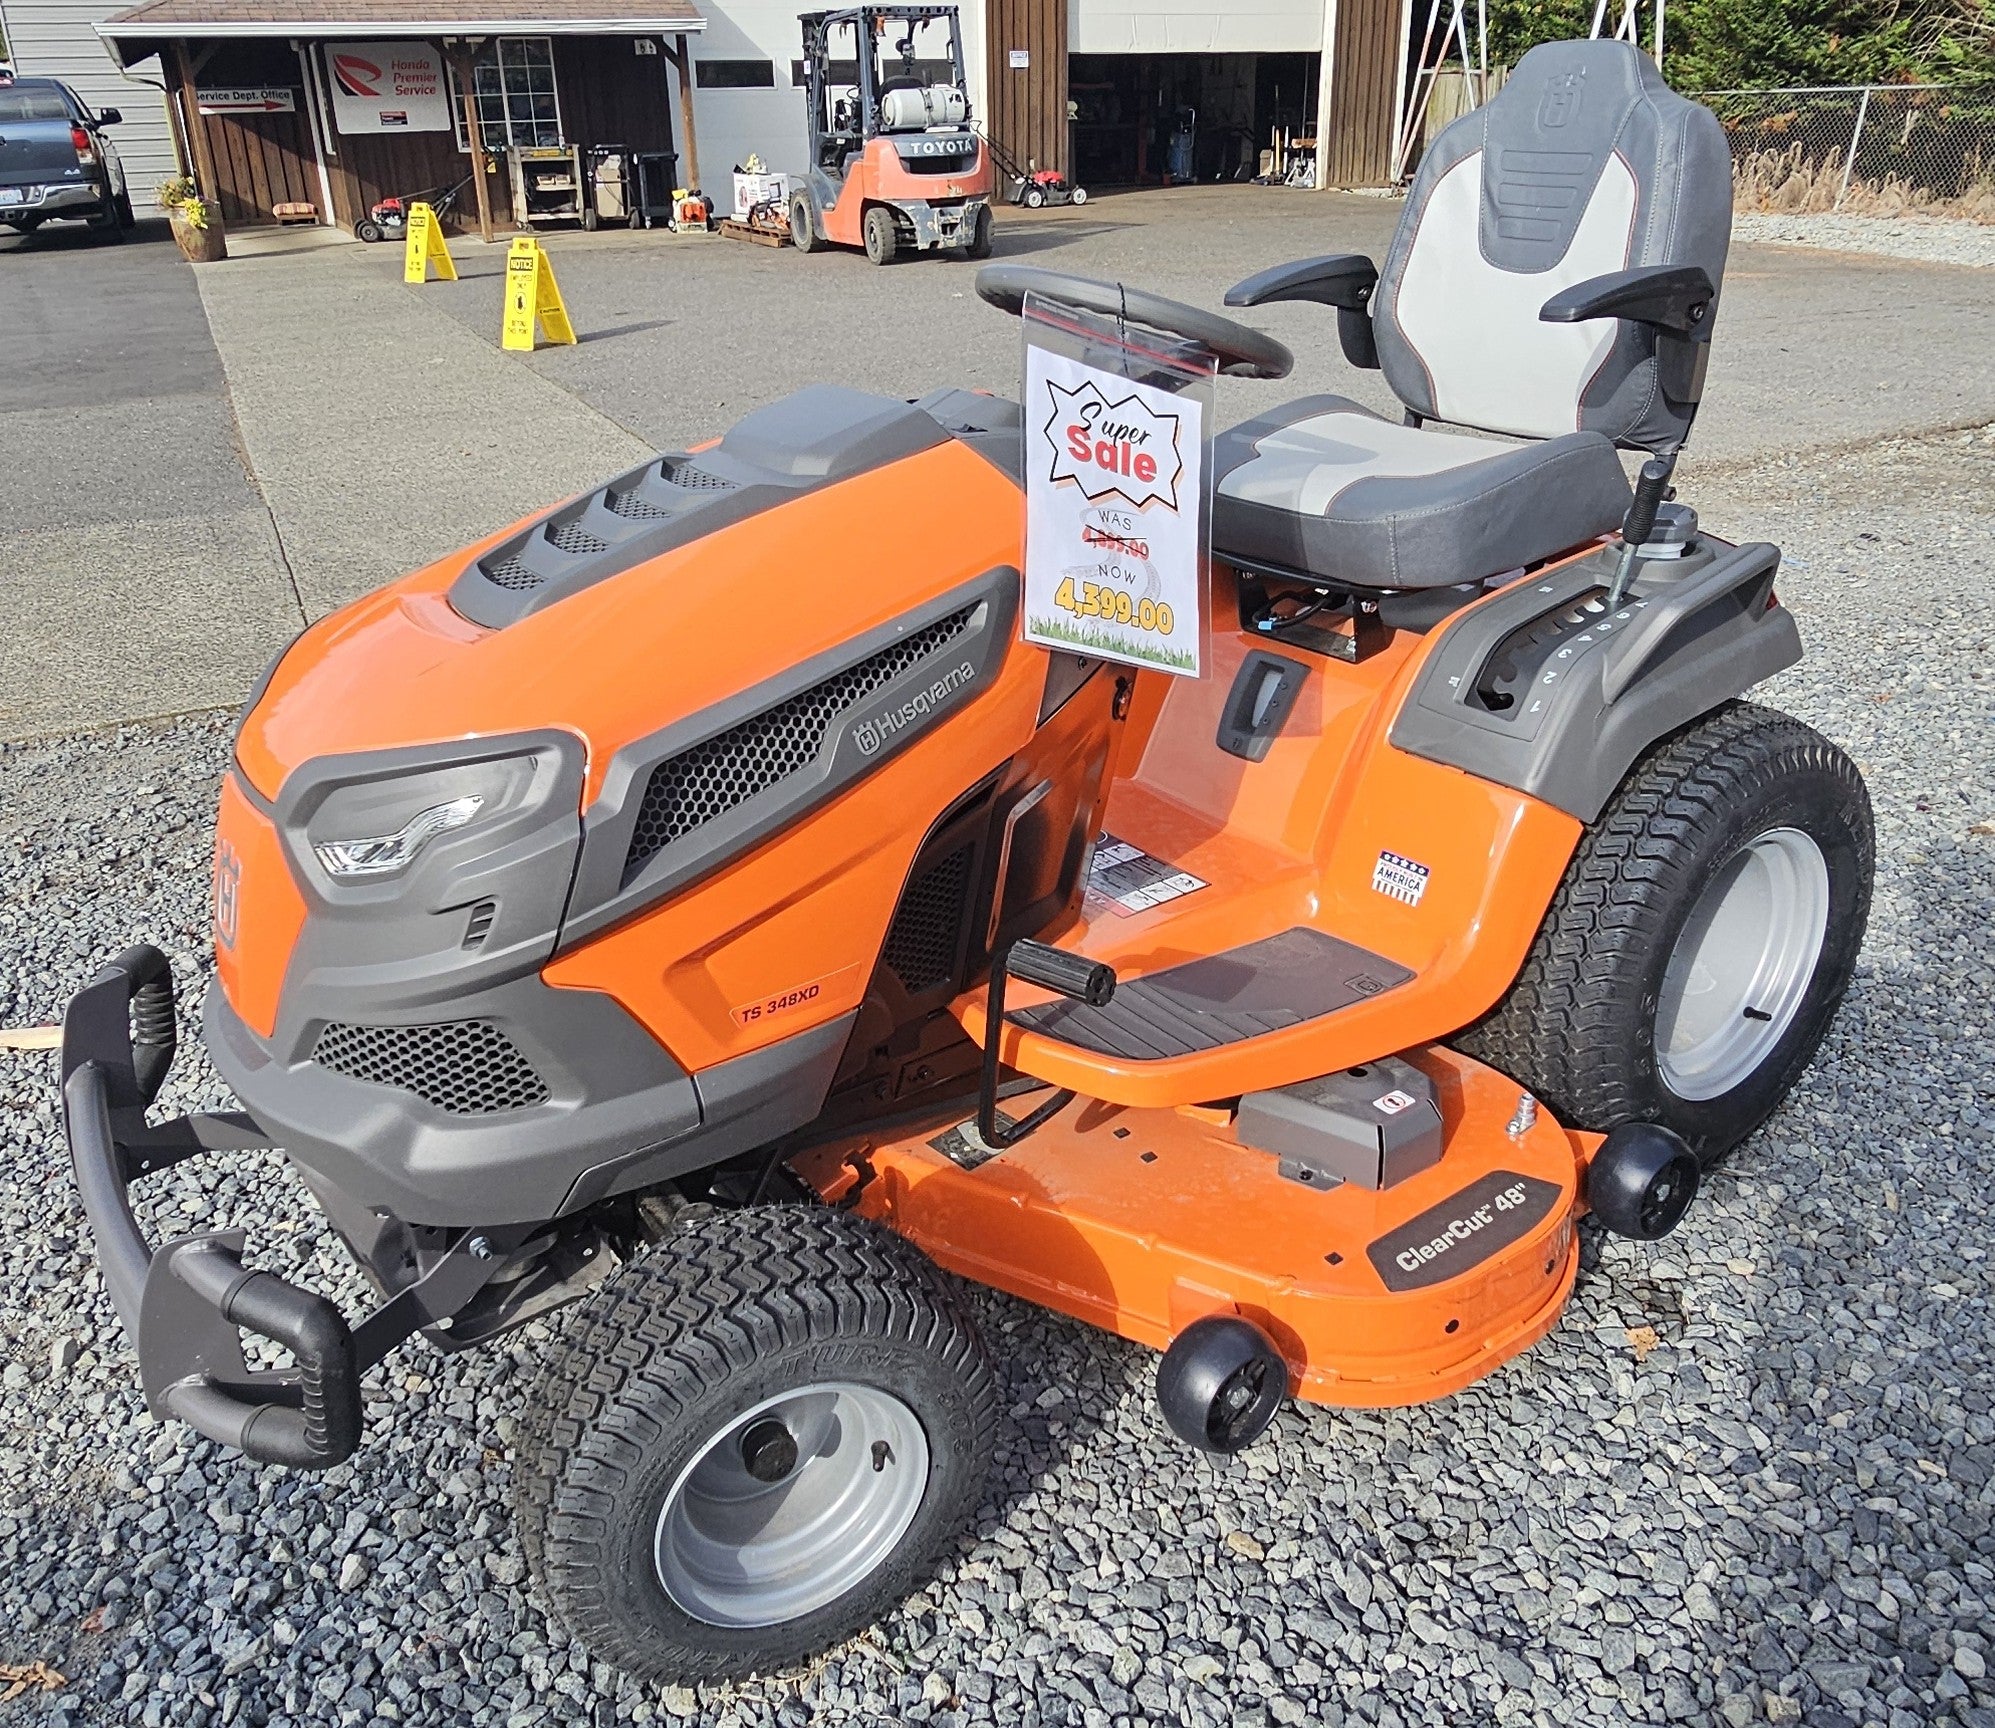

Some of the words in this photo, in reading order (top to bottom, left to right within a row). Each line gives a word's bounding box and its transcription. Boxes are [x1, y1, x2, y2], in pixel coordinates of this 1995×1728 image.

[391, 59, 430, 70] Honda
[393, 73, 438, 83] Premier
[232, 91, 259, 101] Dept.
[261, 90, 290, 99] Office
[395, 84, 437, 96] Service
[910, 138, 973, 155] TOYOTA
[510, 258, 533, 270] NOTICE
[1079, 401, 1153, 448] Super
[1066, 424, 1158, 483] Sale
[1098, 509, 1132, 531] WAS
[1098, 564, 1137, 585] NOW
[1054, 576, 1175, 636] 4,399.00
[1542, 671, 1558, 685] 2
[1558, 648, 1573, 659] 3
[874, 661, 976, 740] Husqvarna
[1376, 866, 1421, 892] AMERICA
[742, 1006, 762, 1023] TS
[766, 985, 820, 1014] 348XD
